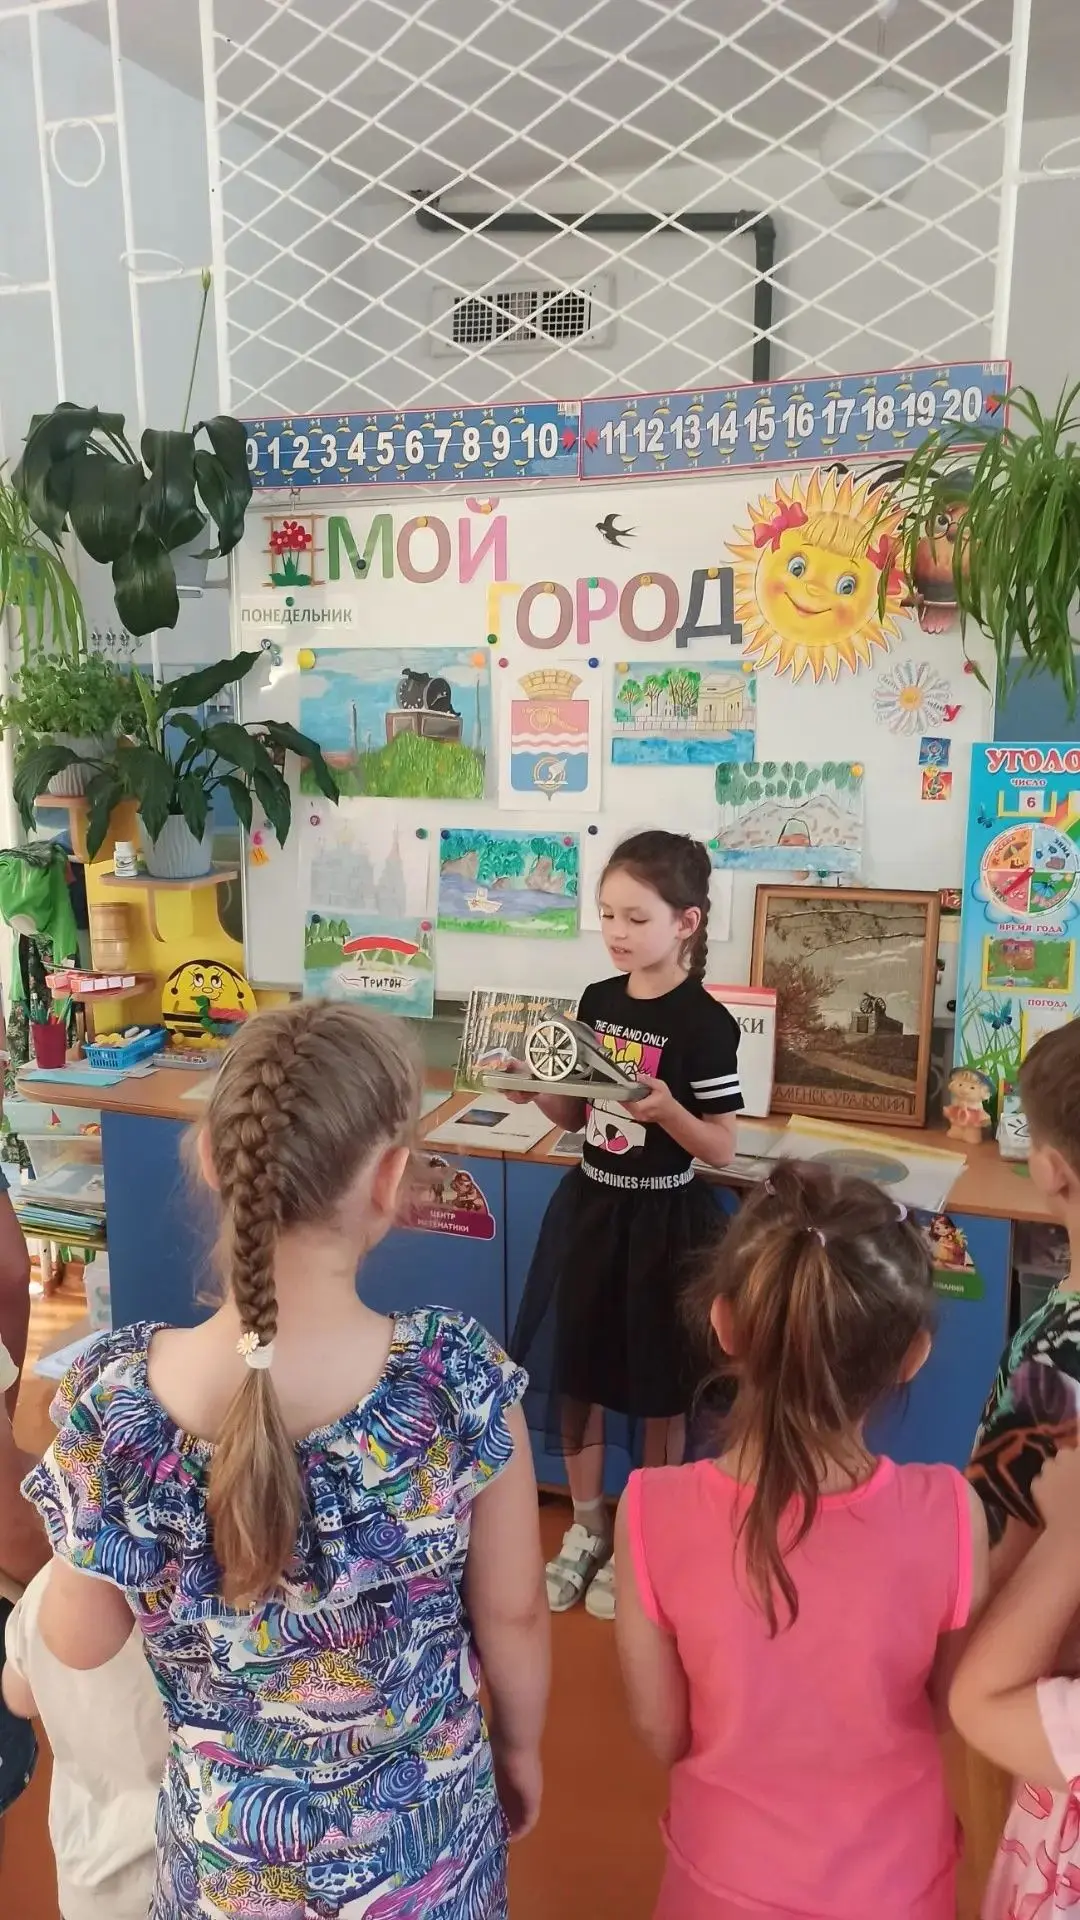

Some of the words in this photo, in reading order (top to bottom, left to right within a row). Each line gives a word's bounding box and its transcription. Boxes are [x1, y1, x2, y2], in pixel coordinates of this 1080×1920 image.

[254, 422, 265, 430] +1
[282, 420, 293, 428] +1
[310, 418, 321, 426] +1
[338, 417, 349, 425] +1
[366, 415, 377, 423] +1
[394, 414, 405, 422] +1
[424, 412, 436, 420] +1
[452, 410, 464, 419] +1
[482, 408, 494, 417] +1
[514, 406, 526, 415] +1
[601, 421, 627, 455] 11
[633, 418, 664, 452] 12
[670, 415, 700, 449] 13
[707, 411, 738, 446] 14
[744, 406, 776, 442] 15
[783, 402, 814, 438] 16
[822, 399, 855, 434] 17
[862, 395, 894, 431] 18
[902, 391, 936, 427] 19
[942, 386, 982, 424] 20
[246, 438, 258, 470] 0
[268, 437, 279, 469] 1
[293, 436, 309, 468] 2
[321, 434, 337, 468] 3
[348, 433, 366, 465] 4
[377, 432, 394, 465] 5
[406, 430, 424, 464] 6
[434, 429, 451, 462] 7
[463, 427, 480, 461] 8
[492, 426, 510, 460] 9
[521, 423, 558, 458] 10
[328, 497, 507, 584] МОЙ
[241, 608, 353, 625] ПОНЕДЕЛЬНИК
[488, 567, 743, 649] ГОРОД
[1011, 779, 1047, 787] ЧИСЛО
[1026, 797, 1036, 808] 6
[999, 924, 1032, 932] ВРЕМЯ
[1036, 925, 1063, 933] ГОДА
[1027, 999, 1068, 1008] ПОГОДА
[594, 1020, 608, 1032] THE
[606, 1023, 624, 1036] ONE
[622, 1027, 642, 1041] AND
[642, 1032, 669, 1047] ONLY
[773, 1086, 905, 1111] АМЕНСК-УРАЛЬСКИЙ
[430, 1210, 456, 1220] ЦЕНТР
